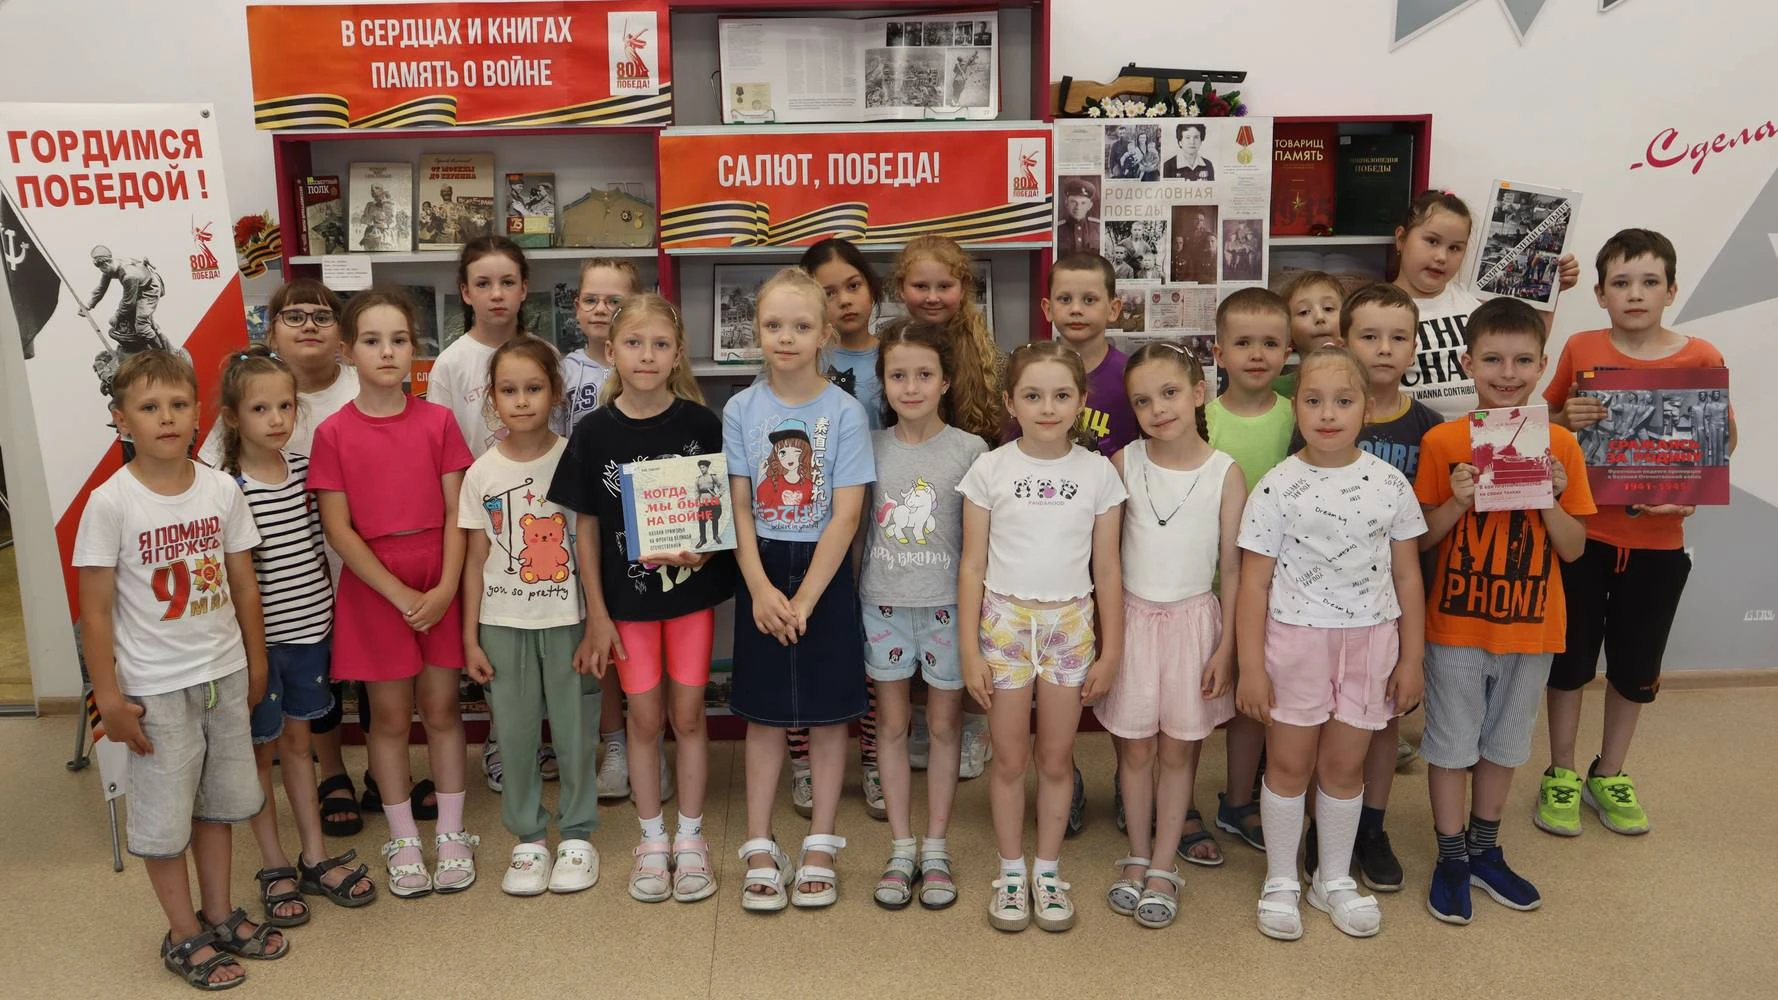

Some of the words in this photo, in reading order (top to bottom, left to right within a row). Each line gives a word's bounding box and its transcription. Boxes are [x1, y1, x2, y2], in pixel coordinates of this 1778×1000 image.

[341, 20, 355, 47] В
[361, 18, 461, 49] СЕРДЦАХ
[467, 18, 482, 45] И
[488, 16, 573, 44] КНИГАХ
[371, 61, 458, 89] ПАМЯТЬ
[463, 60, 477, 87] О
[483, 55, 553, 87] ВОЙНЕ
[616, 62, 634, 78] 80
[616, 79, 650, 89] ПОБЕДА!
[7, 129, 203, 168] ГОРДИМСЯ
[1274, 139, 1324, 149] ТОВАРИЩ
[1274, 150, 1324, 161] ПАМЯТЬ
[718, 153, 820, 190] САЛЮТ,
[828, 151, 940, 188] ПОБЕДА!
[1354, 164, 1392, 174] ПОБЕДЫ
[15, 163, 190, 210] ПОБЕДОЙ
[308, 185, 330, 194] ПОЛК
[1013, 176, 1028, 189] 80
[1013, 189, 1040, 198] ПОБЕДА!
[1104, 186, 1214, 201] РОДОСЛОВНАЯ
[1104, 204, 1164, 217] ПОБЕДЫ
[190, 254, 206, 270] 80
[191, 270, 221, 280] ПОБЕДА!
[1477, 260, 1506, 288] ПАМЯТЬ
[1416, 389, 1442, 400] WANNA
[1606, 452, 1627, 464] ЗА
[644, 486, 688, 499] КОГДА
[647, 515, 665, 526] НА
[669, 511, 713, 524] ВОЙНЕ
[139, 531, 151, 551] Я
[141, 549, 153, 565] Я
[151, 559, 191, 621] 9
[512, 588, 523, 596] so
[528, 585, 569, 601] pretty
